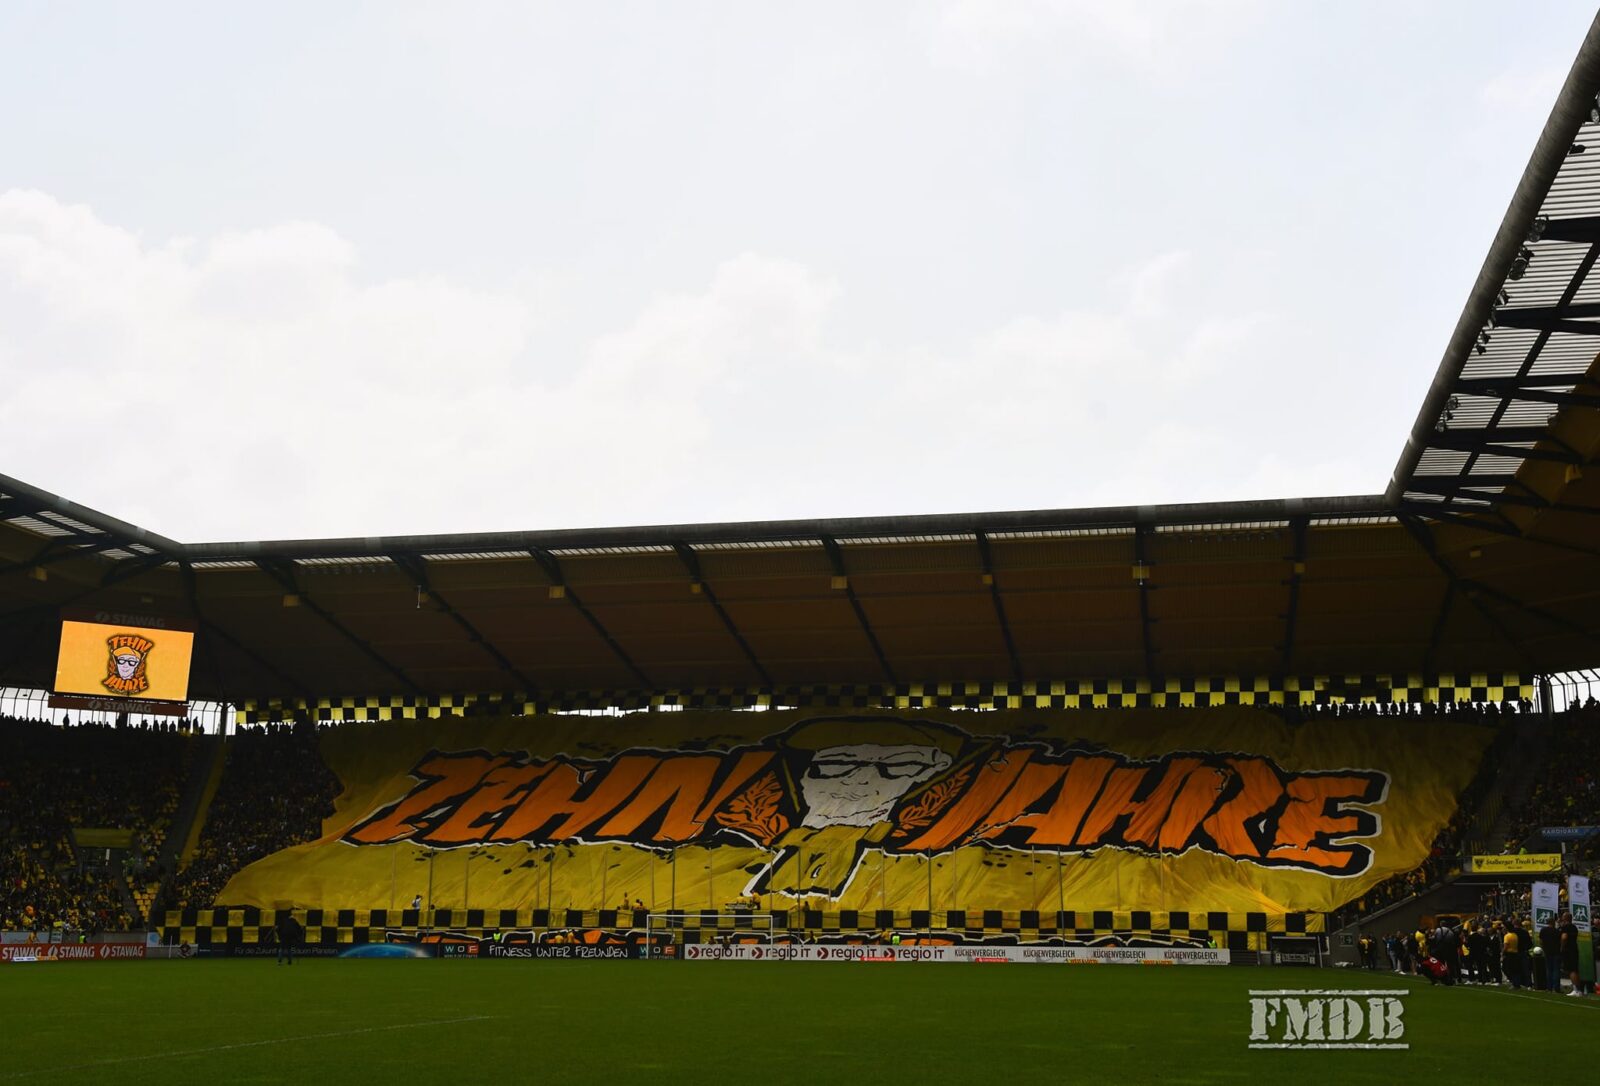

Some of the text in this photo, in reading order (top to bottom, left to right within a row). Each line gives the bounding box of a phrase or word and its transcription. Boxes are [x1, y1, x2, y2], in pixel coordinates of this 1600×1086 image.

[112, 613, 165, 627] STAWAG
[104, 702, 152, 713] STAWAG
[349, 750, 1374, 870] ZEHN JAHRE
[2, 946, 42, 960] STAWAG
[60, 946, 95, 958] STAWAG
[111, 945, 144, 957] STAWAG
[489, 945, 628, 958] FITNESS UNTER FREUNDEN
[701, 945, 732, 960] regio
[765, 945, 797, 960] regio
[831, 946, 863, 961] regio
[897, 947, 930, 961] regio
[955, 949, 1006, 957] KÜCHENVERGLEICH
[1023, 949, 1075, 957] KÜCHENVERGLEICH
[1093, 949, 1146, 958] KÜCHENVERGLEICH
[1164, 950, 1218, 960] KÜCHENVERGLEICH
